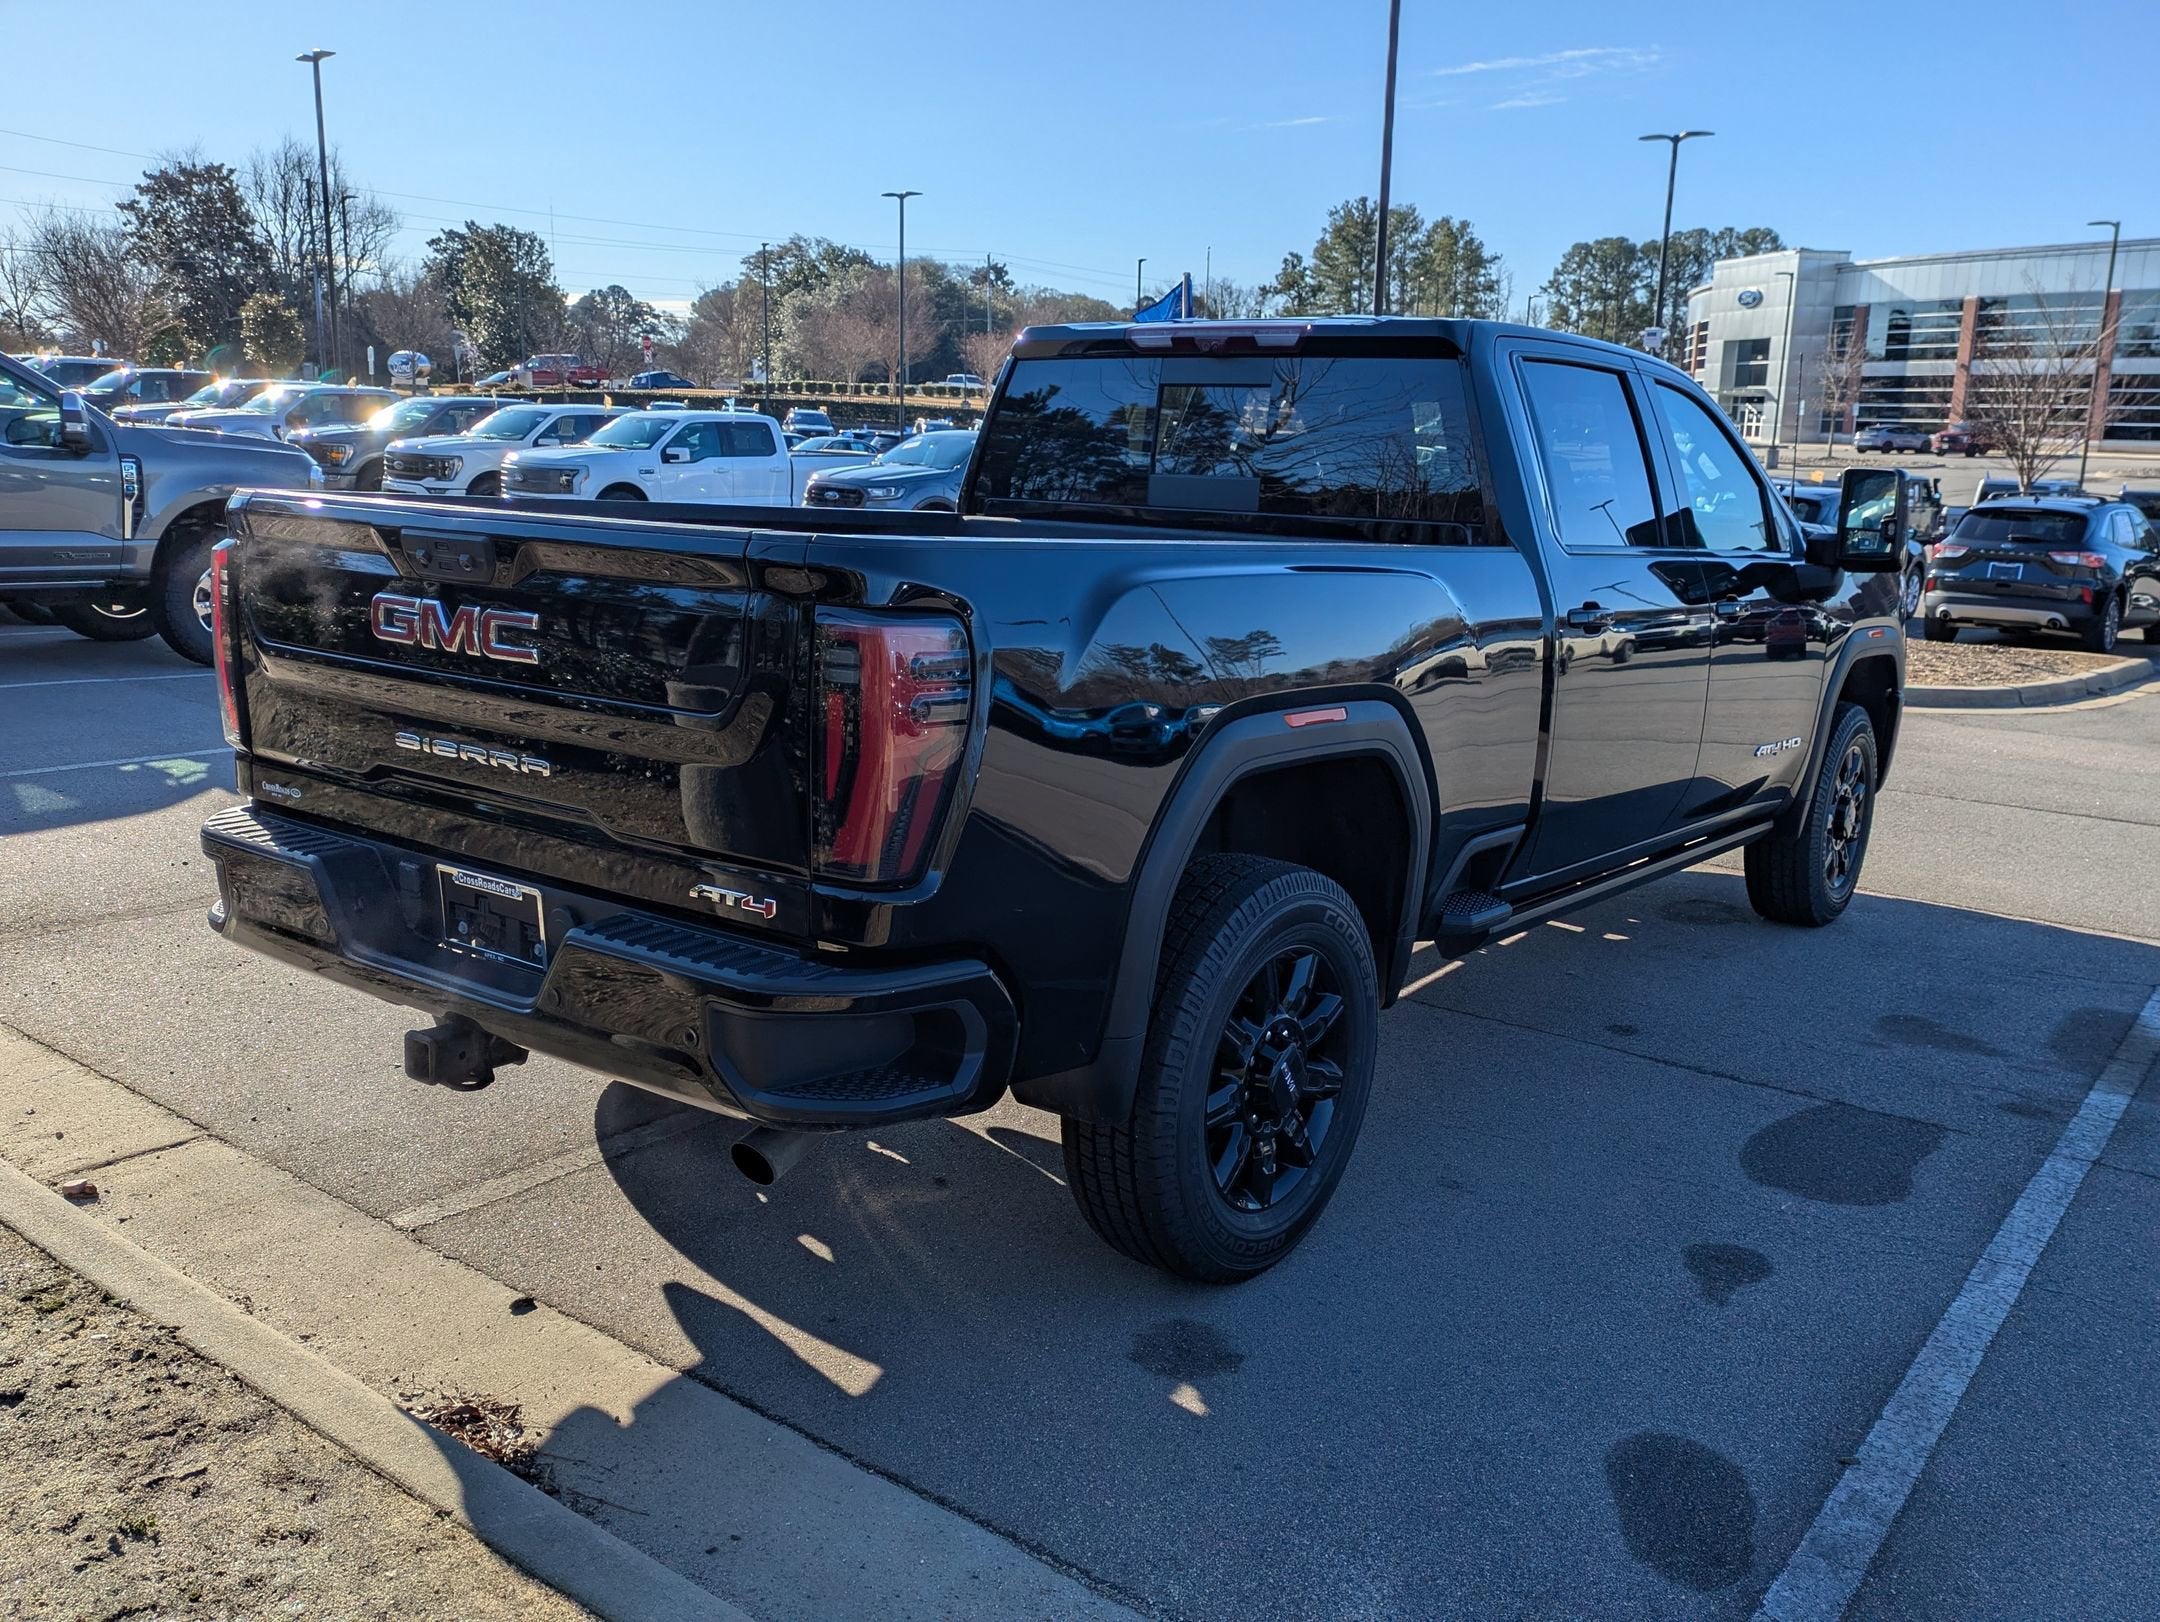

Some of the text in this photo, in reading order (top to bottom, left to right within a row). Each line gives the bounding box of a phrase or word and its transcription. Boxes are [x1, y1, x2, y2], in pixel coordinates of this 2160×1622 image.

[371, 592, 539, 664] GMC
[395, 731, 551, 777] SIERRA
[1782, 736, 1802, 750] HD
[689, 884, 776, 919] AT4
